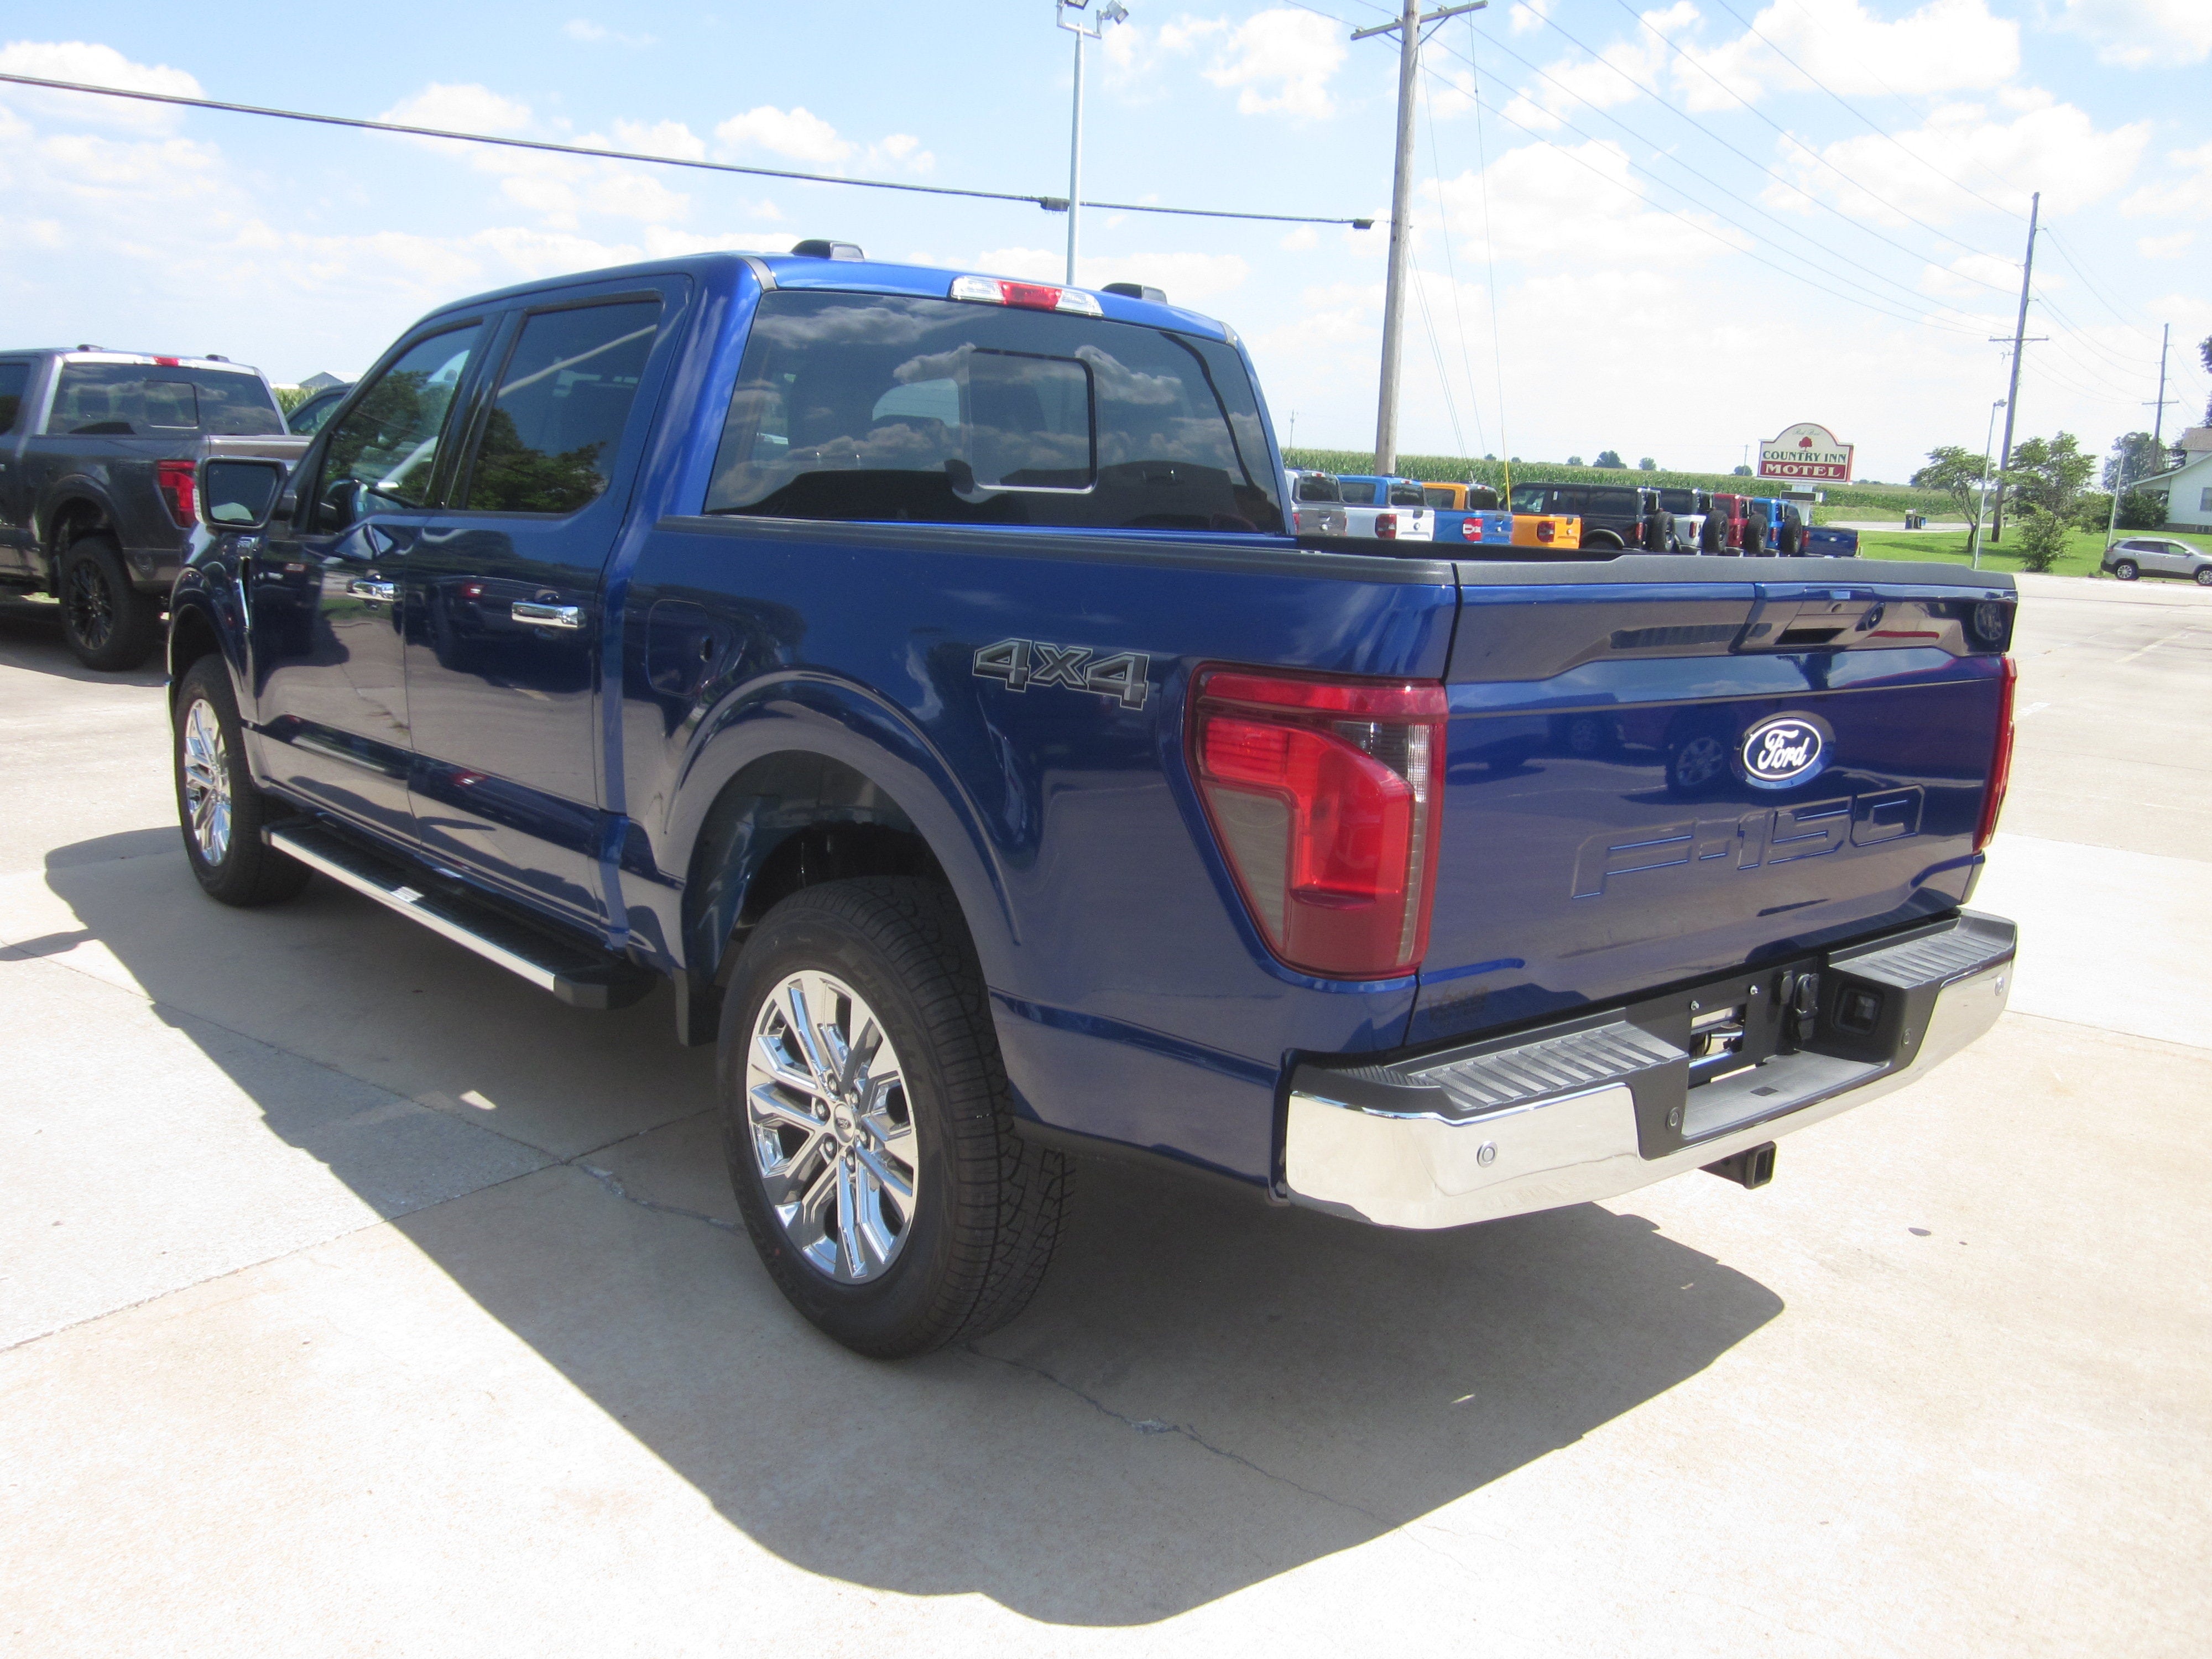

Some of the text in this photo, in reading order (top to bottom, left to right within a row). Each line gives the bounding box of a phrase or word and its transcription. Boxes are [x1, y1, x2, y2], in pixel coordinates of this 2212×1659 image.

[1763, 451, 1846, 463] COUNTRY INN
[1765, 463, 1840, 477] MOTEL
[1757, 729, 1810, 770] Ford
[1572, 784, 1926, 899] F-150
